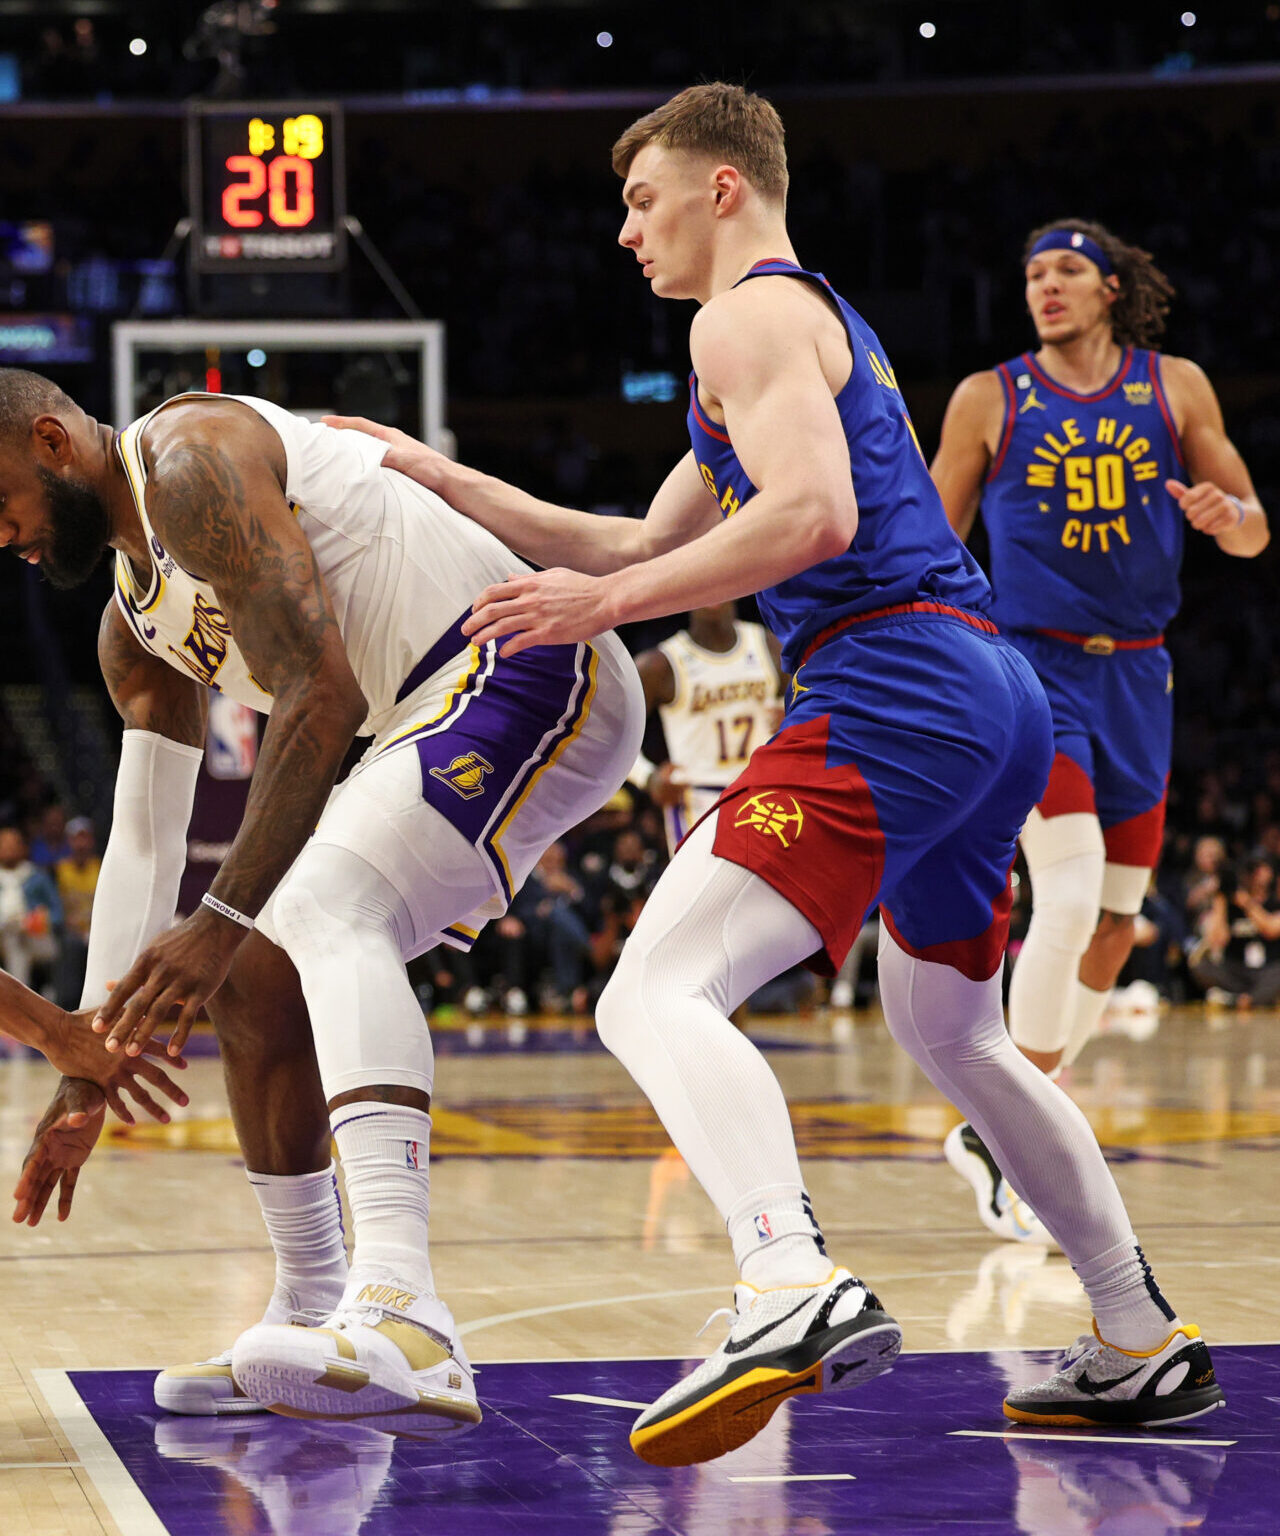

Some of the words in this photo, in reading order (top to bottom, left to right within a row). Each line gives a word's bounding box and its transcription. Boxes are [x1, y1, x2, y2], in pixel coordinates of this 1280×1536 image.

[222, 155, 314, 228] 20
[1026, 418, 1086, 488] MILE
[1095, 417, 1159, 481] HIGH
[1064, 454, 1126, 511] 50
[1061, 515, 1131, 553] CITY
[715, 715, 756, 766] 17
[356, 1284, 418, 1312] NIKE
